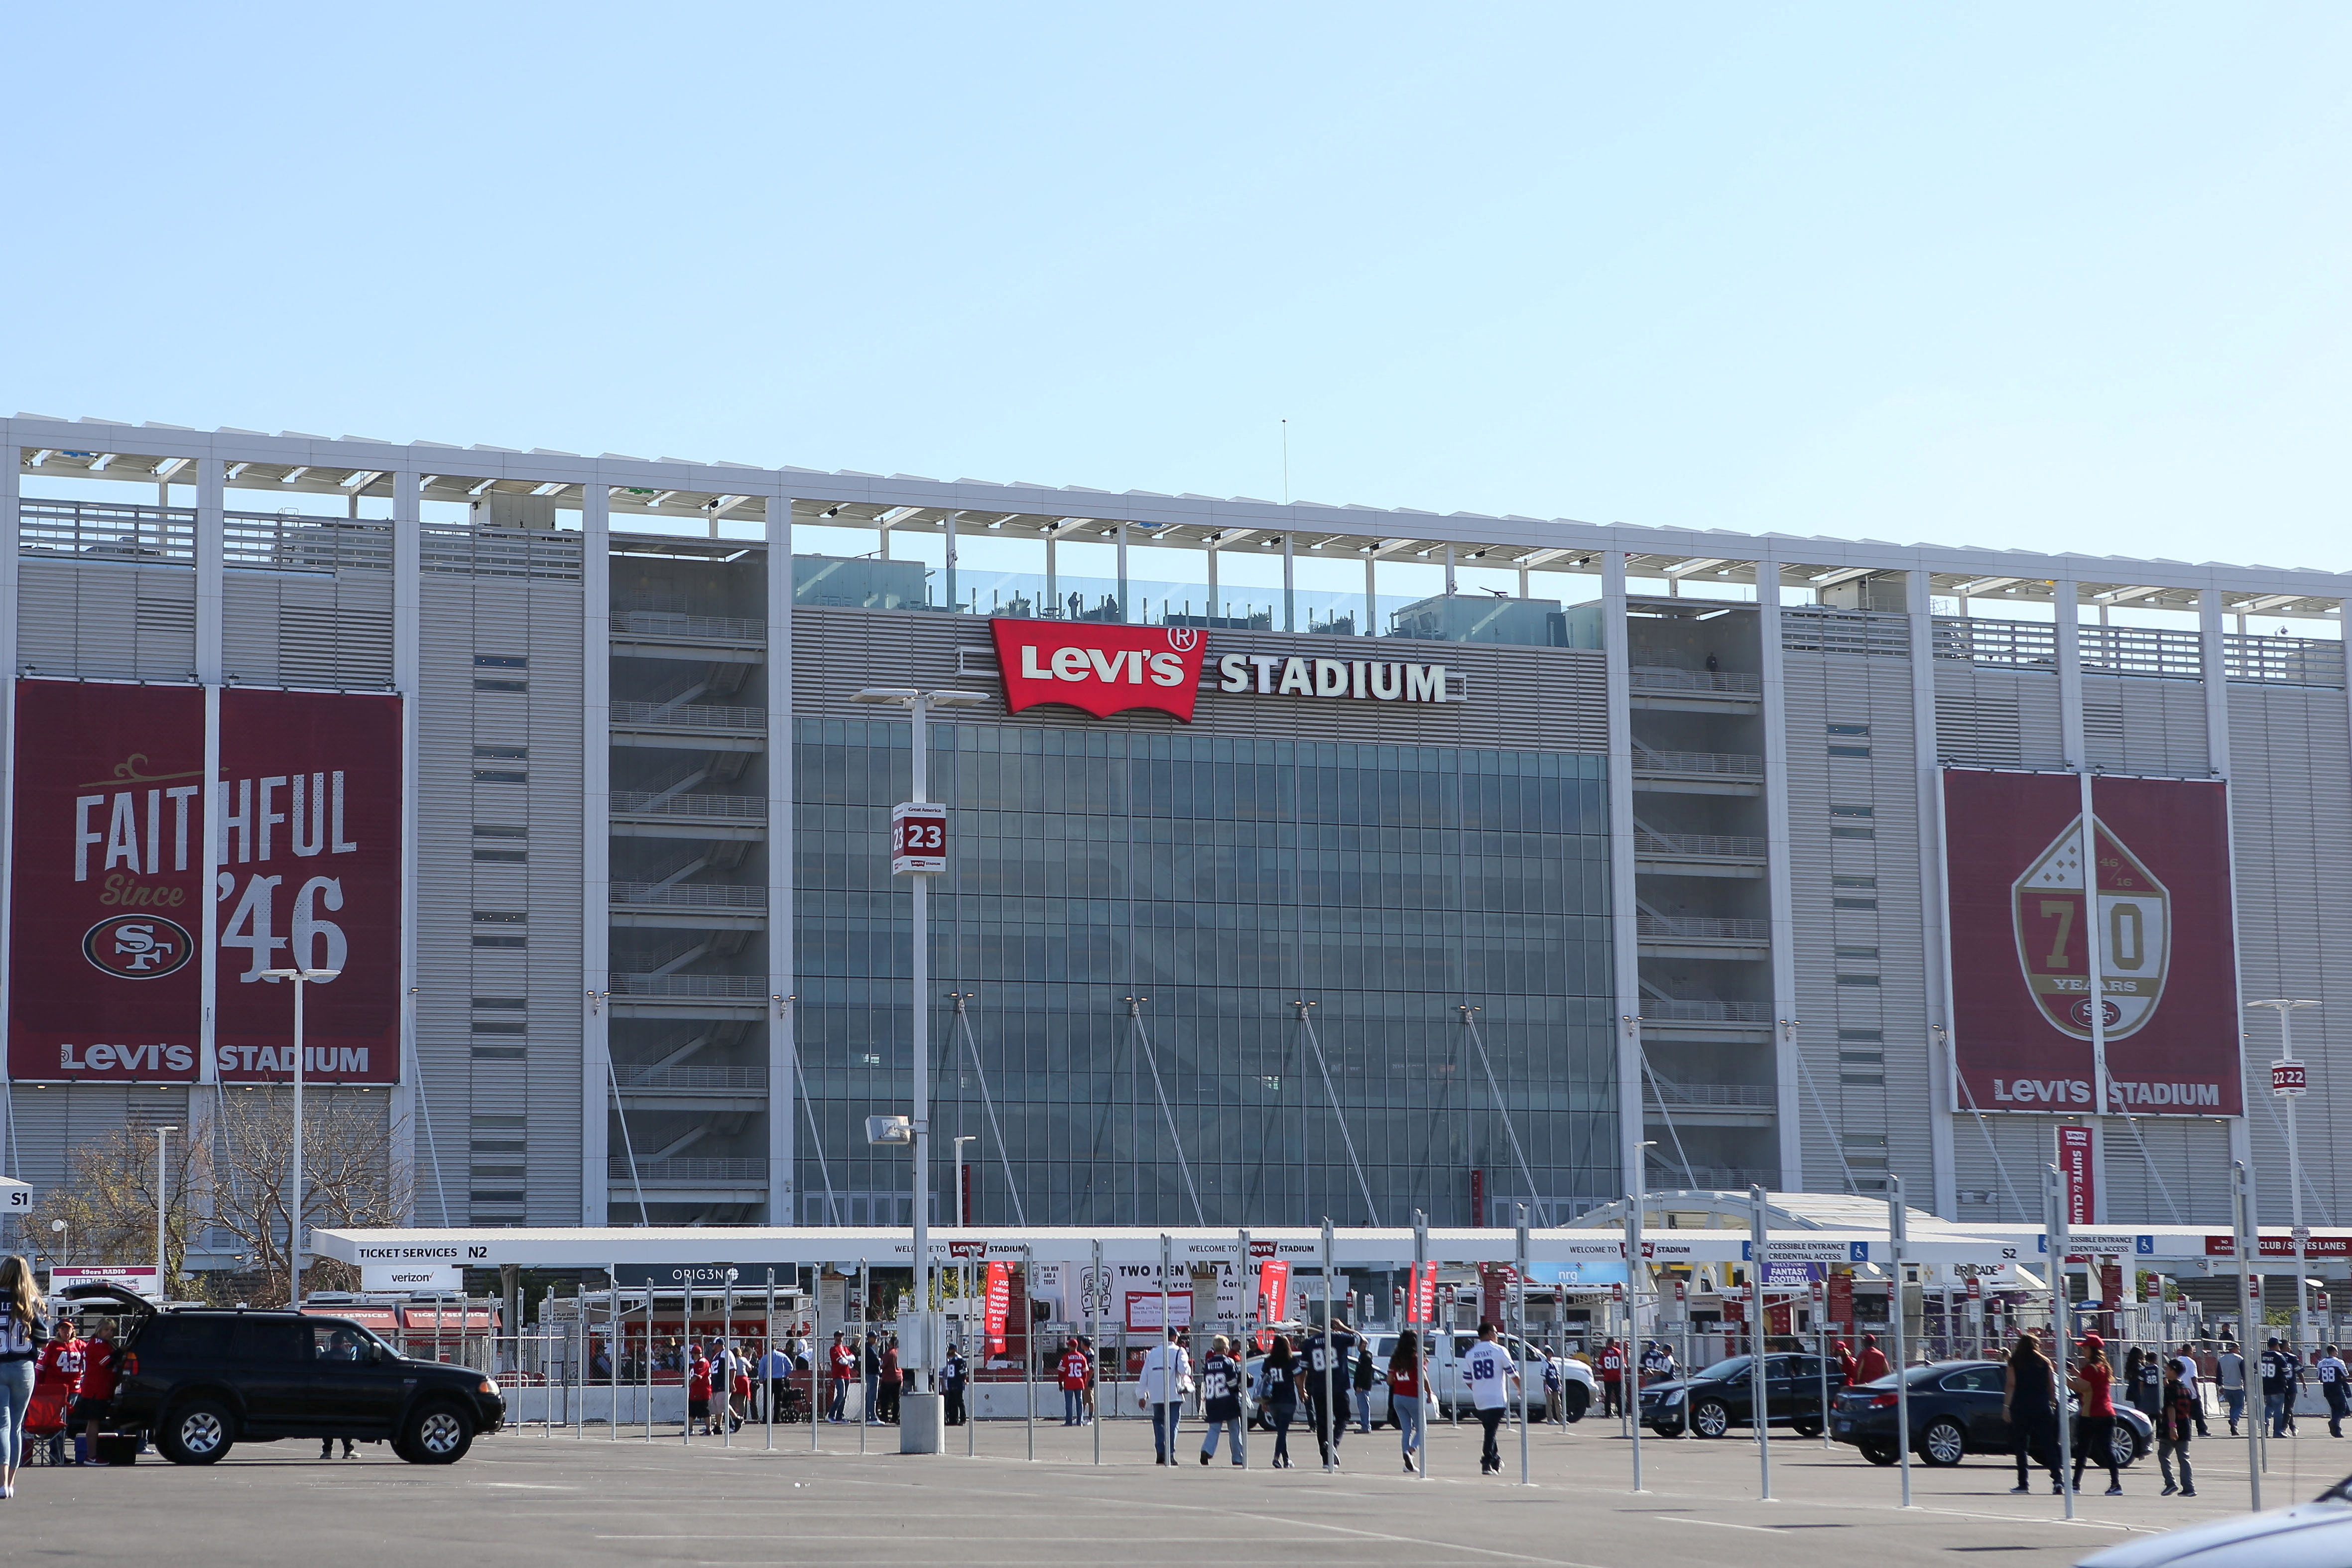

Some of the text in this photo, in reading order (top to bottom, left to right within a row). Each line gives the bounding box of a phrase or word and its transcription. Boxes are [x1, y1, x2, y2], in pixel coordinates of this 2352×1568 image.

[1217, 653, 1446, 702] STADIUM
[75, 770, 357, 881] FAITHFUL
[894, 826, 903, 851] 23
[908, 825, 942, 848] 23
[100, 874, 186, 906] Since
[2053, 979, 2138, 992] YEARS
[218, 1045, 369, 1072] STADIUM
[2273, 1072, 2285, 1084] 22
[2287, 1071, 2304, 1083] 22
[2108, 1082, 2220, 1105] STADIUM
[2073, 1150, 2083, 1184] SUITE
[11, 1193, 28, 1206] S1
[2074, 1195, 2084, 1224] CLUB
[359, 1248, 457, 1258] TICKET SERVICES
[468, 1246, 488, 1258] N2
[2002, 1248, 2017, 1259] S2
[391, 1273, 429, 1282] verizon
[1119, 1265, 1150, 1276] TWO
[1224, 1265, 1233, 1275] A
[1558, 1270, 1578, 1283] nrg
[1955, 1265, 1998, 1276] BRCADE
[56, 1351, 81, 1372] 42
[1473, 1358, 1494, 1380] 88
[1604, 1356, 1619, 1369] 80
[1068, 1362, 1083, 1377] 16
[2322, 1367, 2336, 1382] 88
[1206, 1372, 1231, 1399] 82
